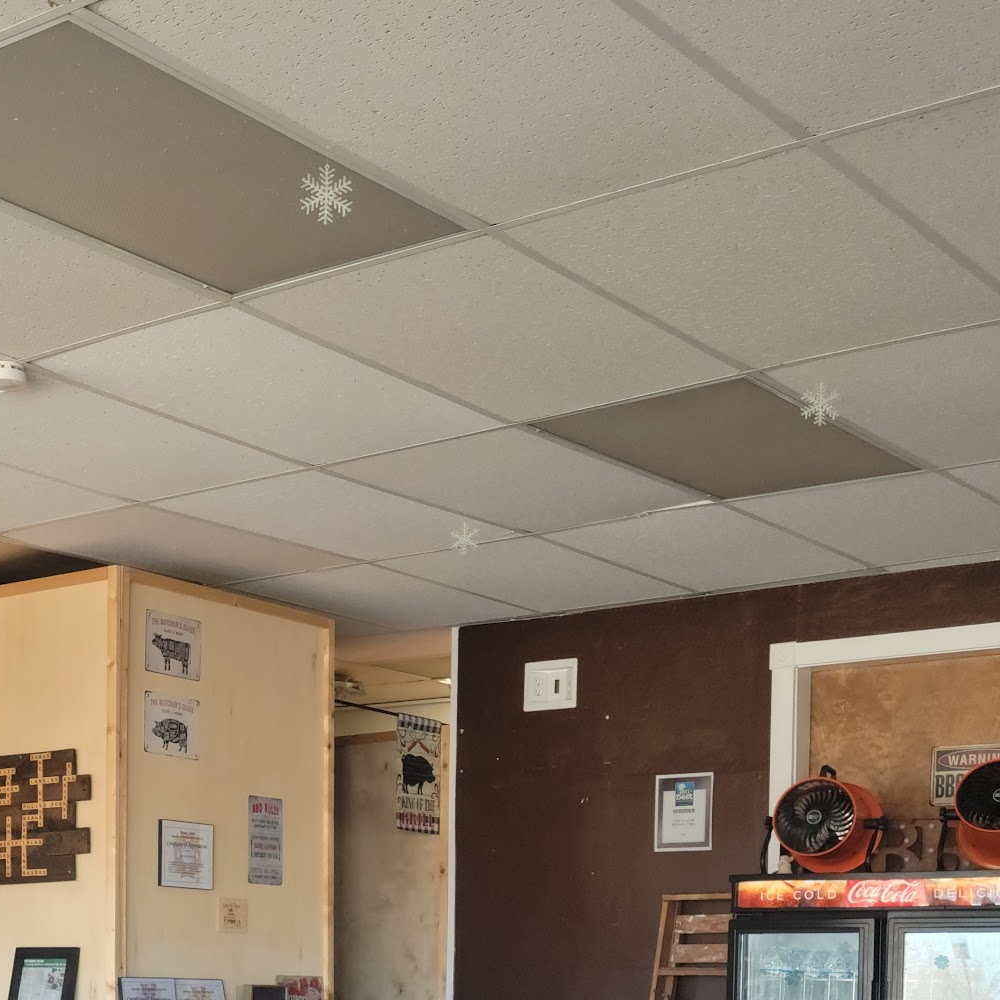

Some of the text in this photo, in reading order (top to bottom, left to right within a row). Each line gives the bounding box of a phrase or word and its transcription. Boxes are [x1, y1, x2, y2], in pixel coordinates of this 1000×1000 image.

[935, 773, 965, 798] BB
[760, 890, 784, 901] ICE
[792, 889, 837, 900] COLD
[847, 880, 921, 904] Coca-Cola
